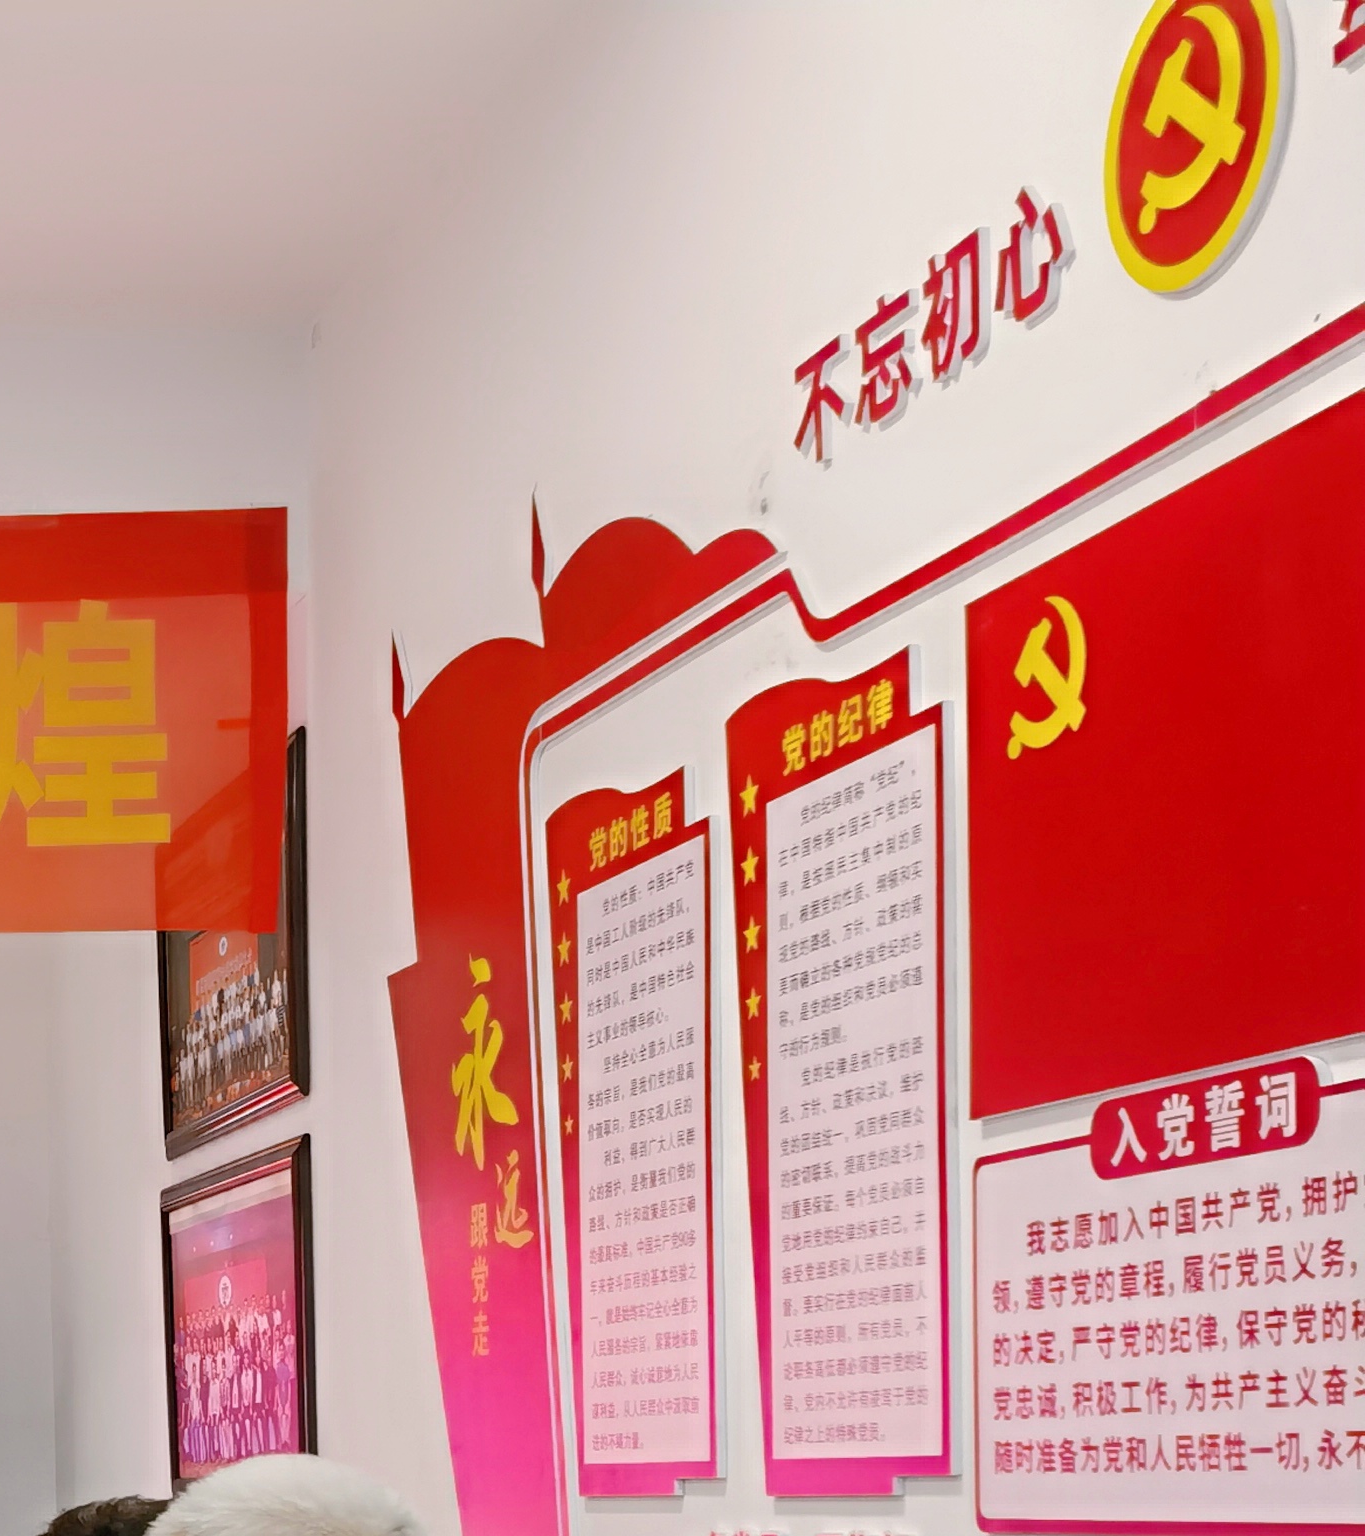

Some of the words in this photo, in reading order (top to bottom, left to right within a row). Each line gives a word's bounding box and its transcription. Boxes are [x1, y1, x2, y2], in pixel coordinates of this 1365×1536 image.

[794, 189, 1067, 464] 不忘初心
[781, 678, 895, 777] 党的纪律
[589, 790, 673, 871] 党的性质
[1111, 1071, 1298, 1168] 入党誓词
[1026, 1171, 1365, 1256] 我志愿加入中国共产党，拥护
[469, 1201, 490, 1357] 跟党走
